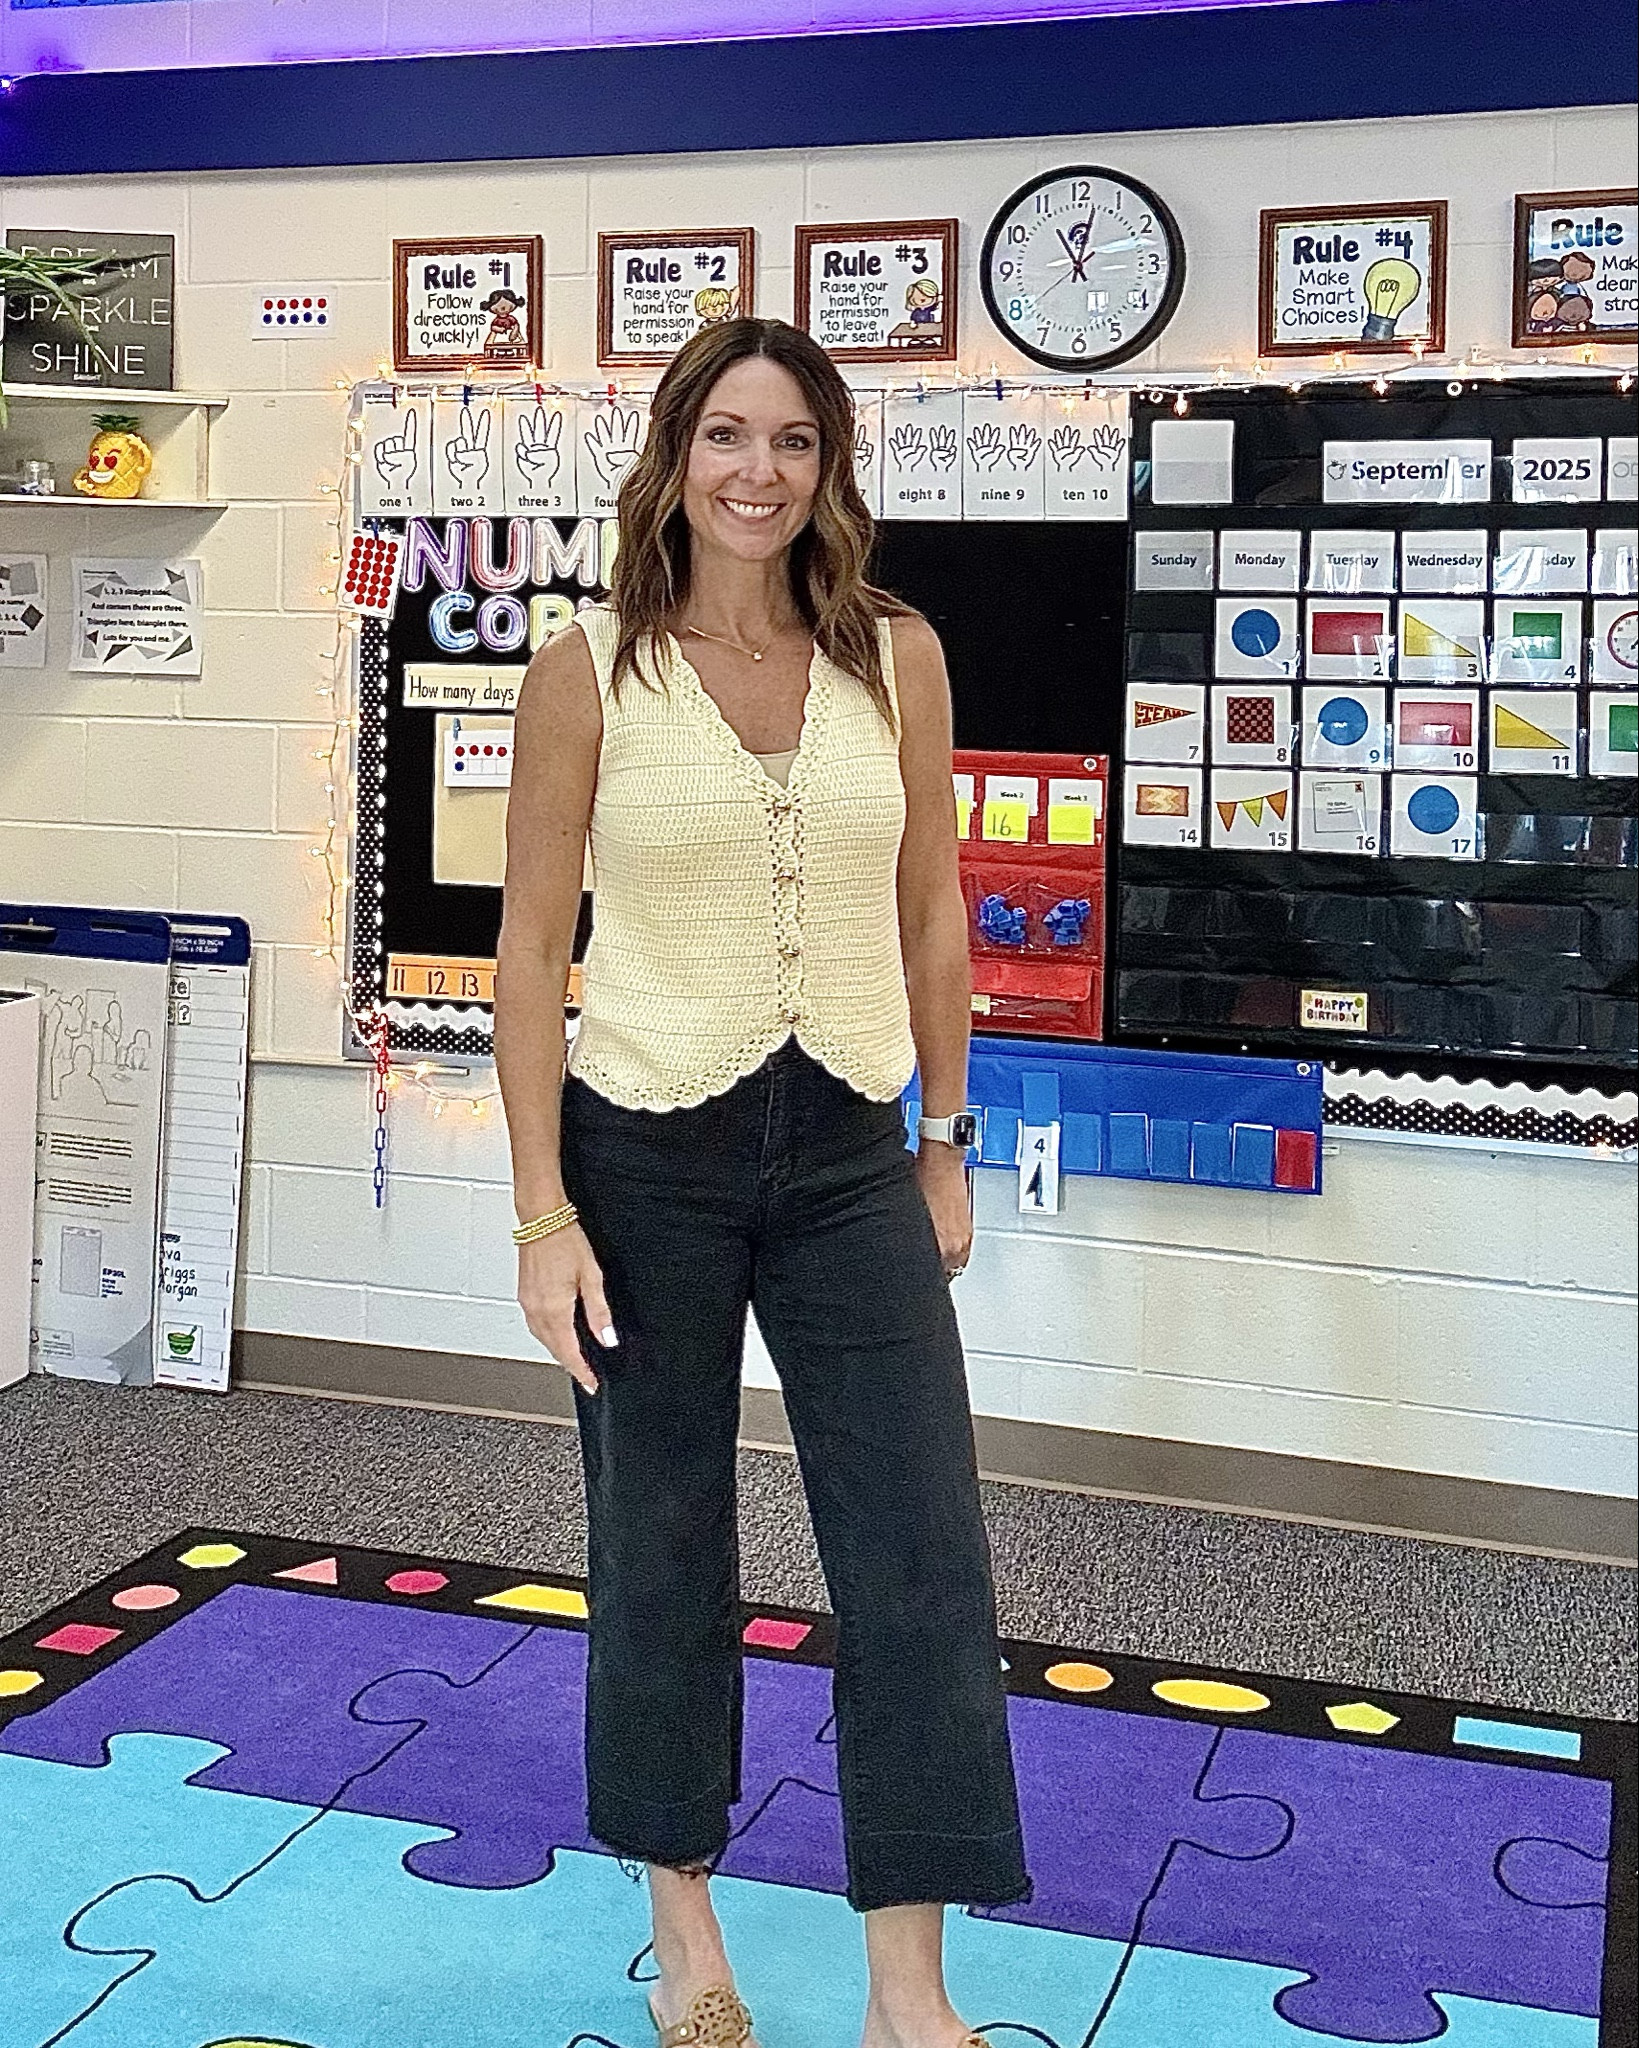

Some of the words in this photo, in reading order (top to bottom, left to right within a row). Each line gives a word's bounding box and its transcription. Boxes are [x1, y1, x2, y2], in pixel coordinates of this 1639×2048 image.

[1072, 181, 1090, 201] 12
[1036, 194, 1050, 214] 11
[1116, 191, 1122, 210] 1
[1140, 214, 1152, 234] 2
[1007, 224, 1026, 244] 10
[1551, 216, 1624, 250] Rule
[1292, 235, 1361, 265] Rule
[1375, 228, 1413, 260] #4
[626, 257, 682, 284] Rule
[694, 252, 727, 281] #2
[823, 251, 882, 278] Rule
[895, 244, 929, 273] #3
[1148, 254, 1160, 274] 3
[424, 264, 477, 290] Rule
[488, 258, 511, 287] #1
[1000, 261, 1014, 282] 9
[1299, 269, 1350, 286] Make
[623, 287, 660, 300] Raise
[664, 288, 695, 302] your
[820, 281, 857, 294] Raise
[860, 282, 889, 296] your
[427, 294, 474, 309] Follow
[829, 294, 859, 307] hand
[861, 294, 885, 307] for
[1292, 288, 1356, 306] Smart
[6, 294, 171, 325] SPARKLE
[633, 300, 663, 314] hand
[665, 301, 690, 313] for
[820, 307, 889, 321] permission
[1008, 300, 1022, 320] 8
[414, 311, 486, 327] directions
[623, 316, 695, 333] permission
[825, 320, 840, 331] to
[843, 319, 877, 331] leave
[1281, 308, 1366, 326] Choices!
[420, 328, 479, 345] quickly!
[627, 331, 642, 343] to
[646, 330, 690, 346] speak!
[819, 332, 848, 345] your
[851, 331, 885, 343] seat!
[1037, 327, 1050, 346] 7
[1110, 322, 1122, 342] 5
[1071, 332, 1086, 354] 6
[30, 343, 146, 375] SHINE
[1523, 458, 1591, 481] 2025
[379, 497, 401, 507] one
[407, 496, 413, 507] 1
[451, 497, 473, 507] two
[477, 496, 486, 507] 2
[518, 496, 549, 507] three
[554, 496, 562, 507] 3
[899, 489, 933, 503] eight
[937, 489, 946, 501] 8
[981, 489, 1011, 501] nine
[1016, 489, 1025, 501] 9
[1063, 489, 1085, 501] ten
[1093, 489, 1109, 501] 10
[1151, 554, 1198, 567] Sunday
[1235, 554, 1286, 568] Monday
[1326, 554, 1379, 568] Tuesday
[1407, 553, 1483, 568] Wednesday
[429, 593, 595, 653] COR
[1282, 661, 1290, 675] 1
[1373, 661, 1383, 676] 2
[1467, 663, 1478, 677] 3
[1564, 665, 1577, 679] 4
[409, 675, 438, 698] How
[443, 685, 476, 707] many
[483, 676, 514, 708] days
[1189, 746, 1199, 760] 7
[1276, 748, 1287, 762] 8
[1369, 750, 1380, 764] 9
[1453, 752, 1474, 767] 10
[1552, 755, 1570, 770] 11
[992, 812, 1012, 836] 16
[1179, 829, 1198, 843] 14
[1268, 831, 1288, 847] 15
[1356, 835, 1376, 850] 16
[1451, 838, 1471, 853] 17
[393, 968, 405, 992] 11
[427, 970, 449, 995] 12
[461, 973, 479, 996] 13
[1315, 998, 1354, 1012] HAPPY
[1307, 1008, 1359, 1023] BIRTHDAY
[1034, 1138, 1046, 1154] 4
[161, 1266, 196, 1284] riggs
[160, 1283, 198, 1303] organ
